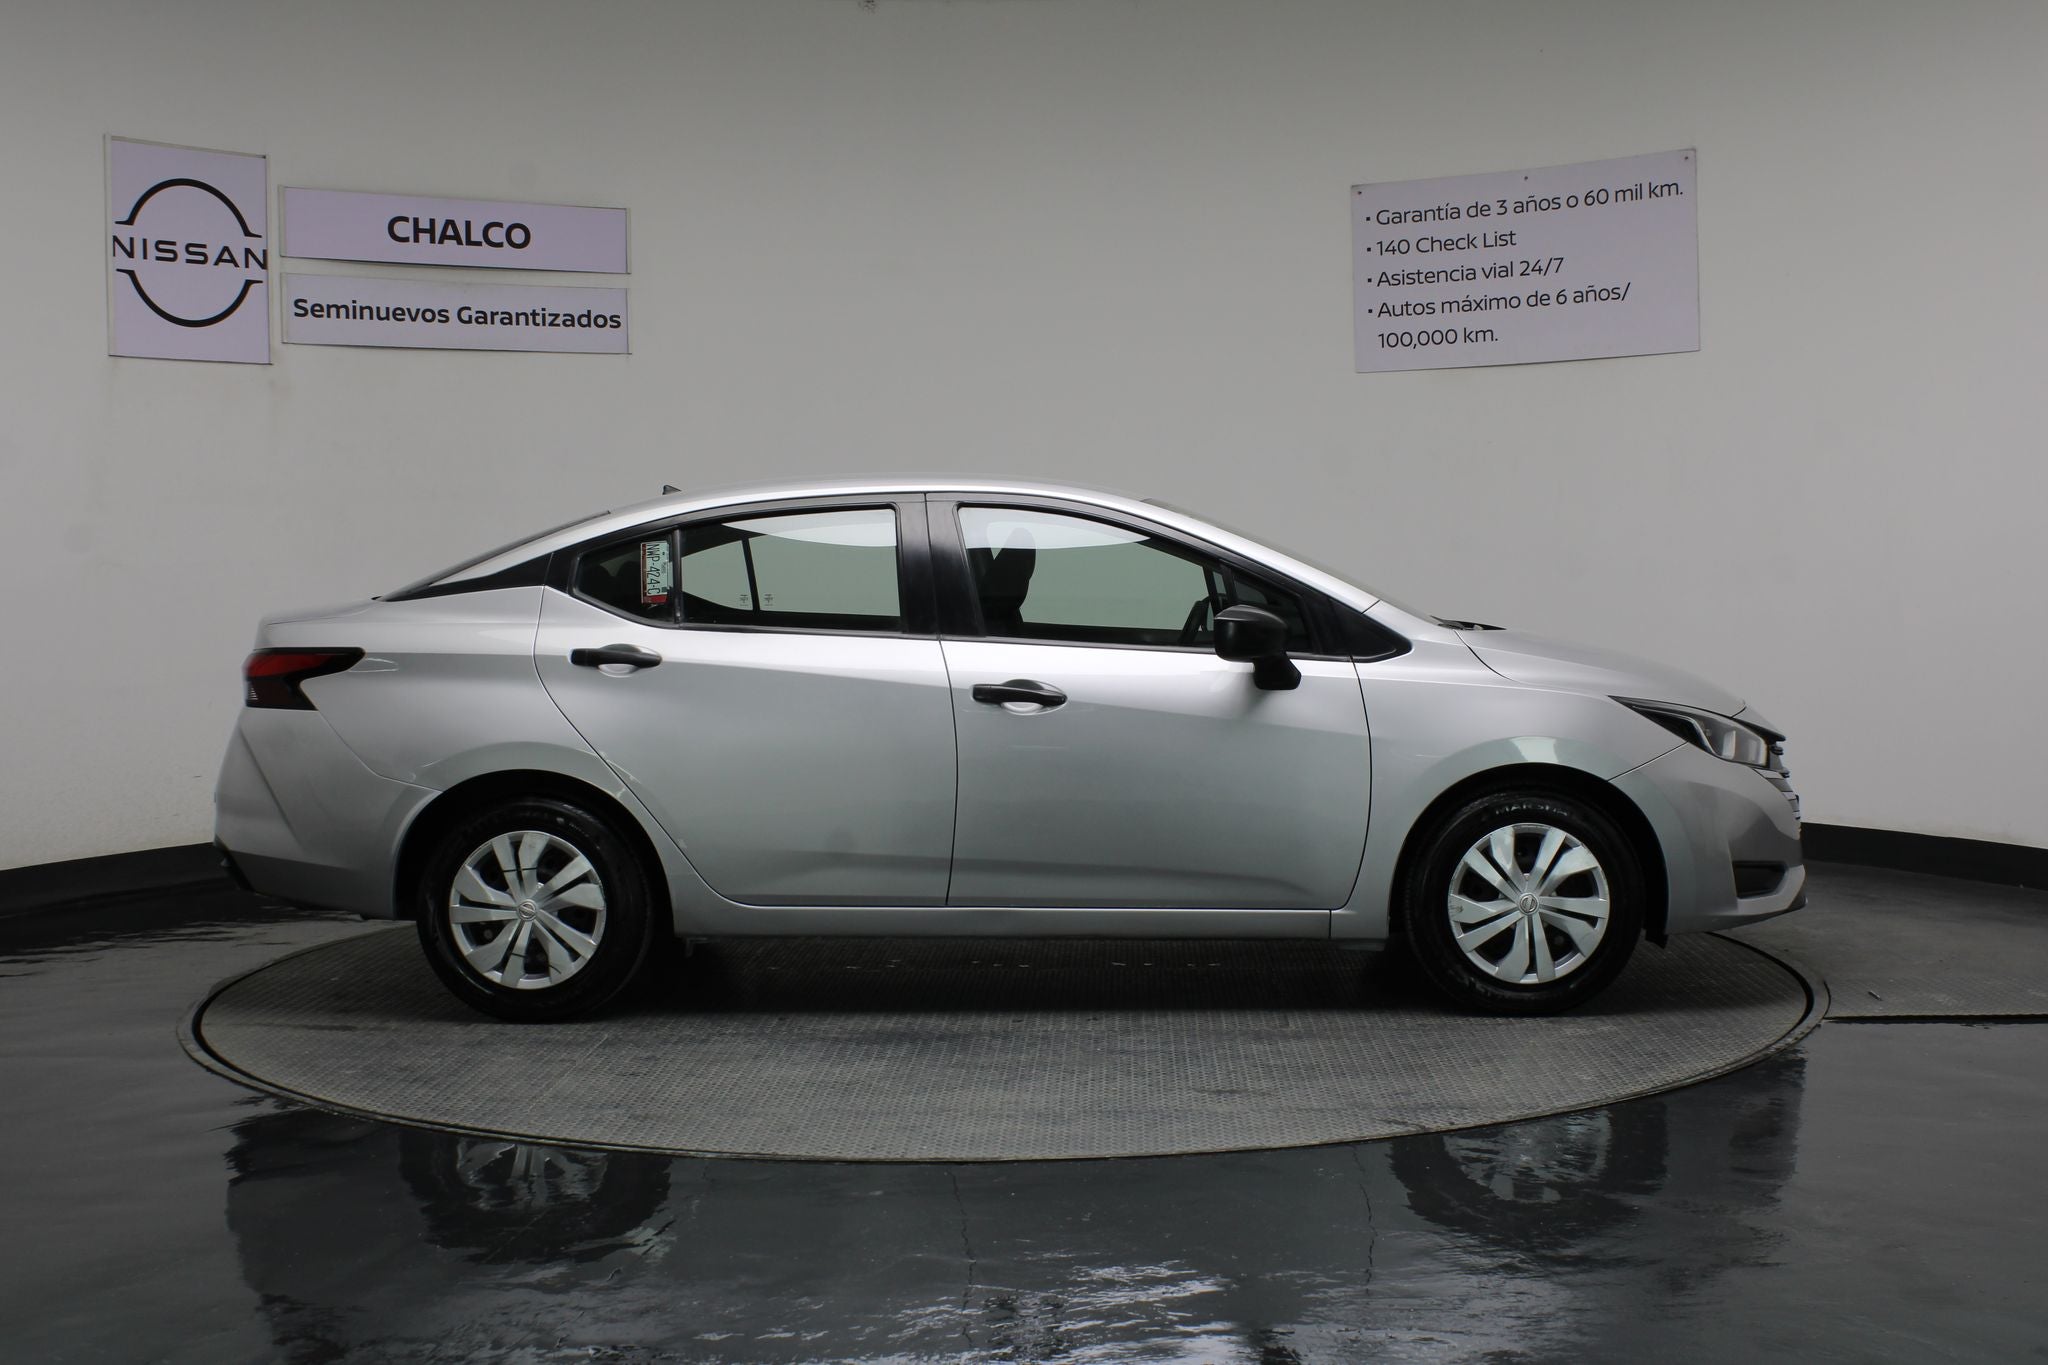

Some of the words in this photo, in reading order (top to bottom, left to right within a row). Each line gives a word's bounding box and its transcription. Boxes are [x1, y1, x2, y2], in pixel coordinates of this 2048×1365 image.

[1376, 203, 1460, 225] Garantía
[1467, 201, 1491, 218] de
[1497, 200, 1507, 215] 3
[1513, 195, 1561, 214] años
[1566, 195, 1578, 208] o
[1584, 189, 1609, 206] 60
[1615, 183, 1642, 203] mil
[1649, 182, 1683, 199] km.
[388, 216, 531, 249] CHALCO
[1376, 239, 1410, 256] 140
[1416, 233, 1478, 253] Check
[1483, 231, 1517, 248] List
[113, 235, 267, 270] NISSAN
[1377, 265, 1476, 287] Asistencia
[1482, 261, 1513, 279] vial
[1520, 257, 1564, 276] 24/7
[294, 298, 450, 323] Seminuevos
[457, 306, 621, 329] Garantizados
[1378, 301, 1435, 318] Autos
[1441, 295, 1521, 313] máximo
[1526, 290, 1550, 307] de
[1556, 289, 1567, 305] 6
[1573, 282, 1631, 303] años/
[1378, 329, 1457, 349] 100,000
[1464, 327, 1498, 343] km.
